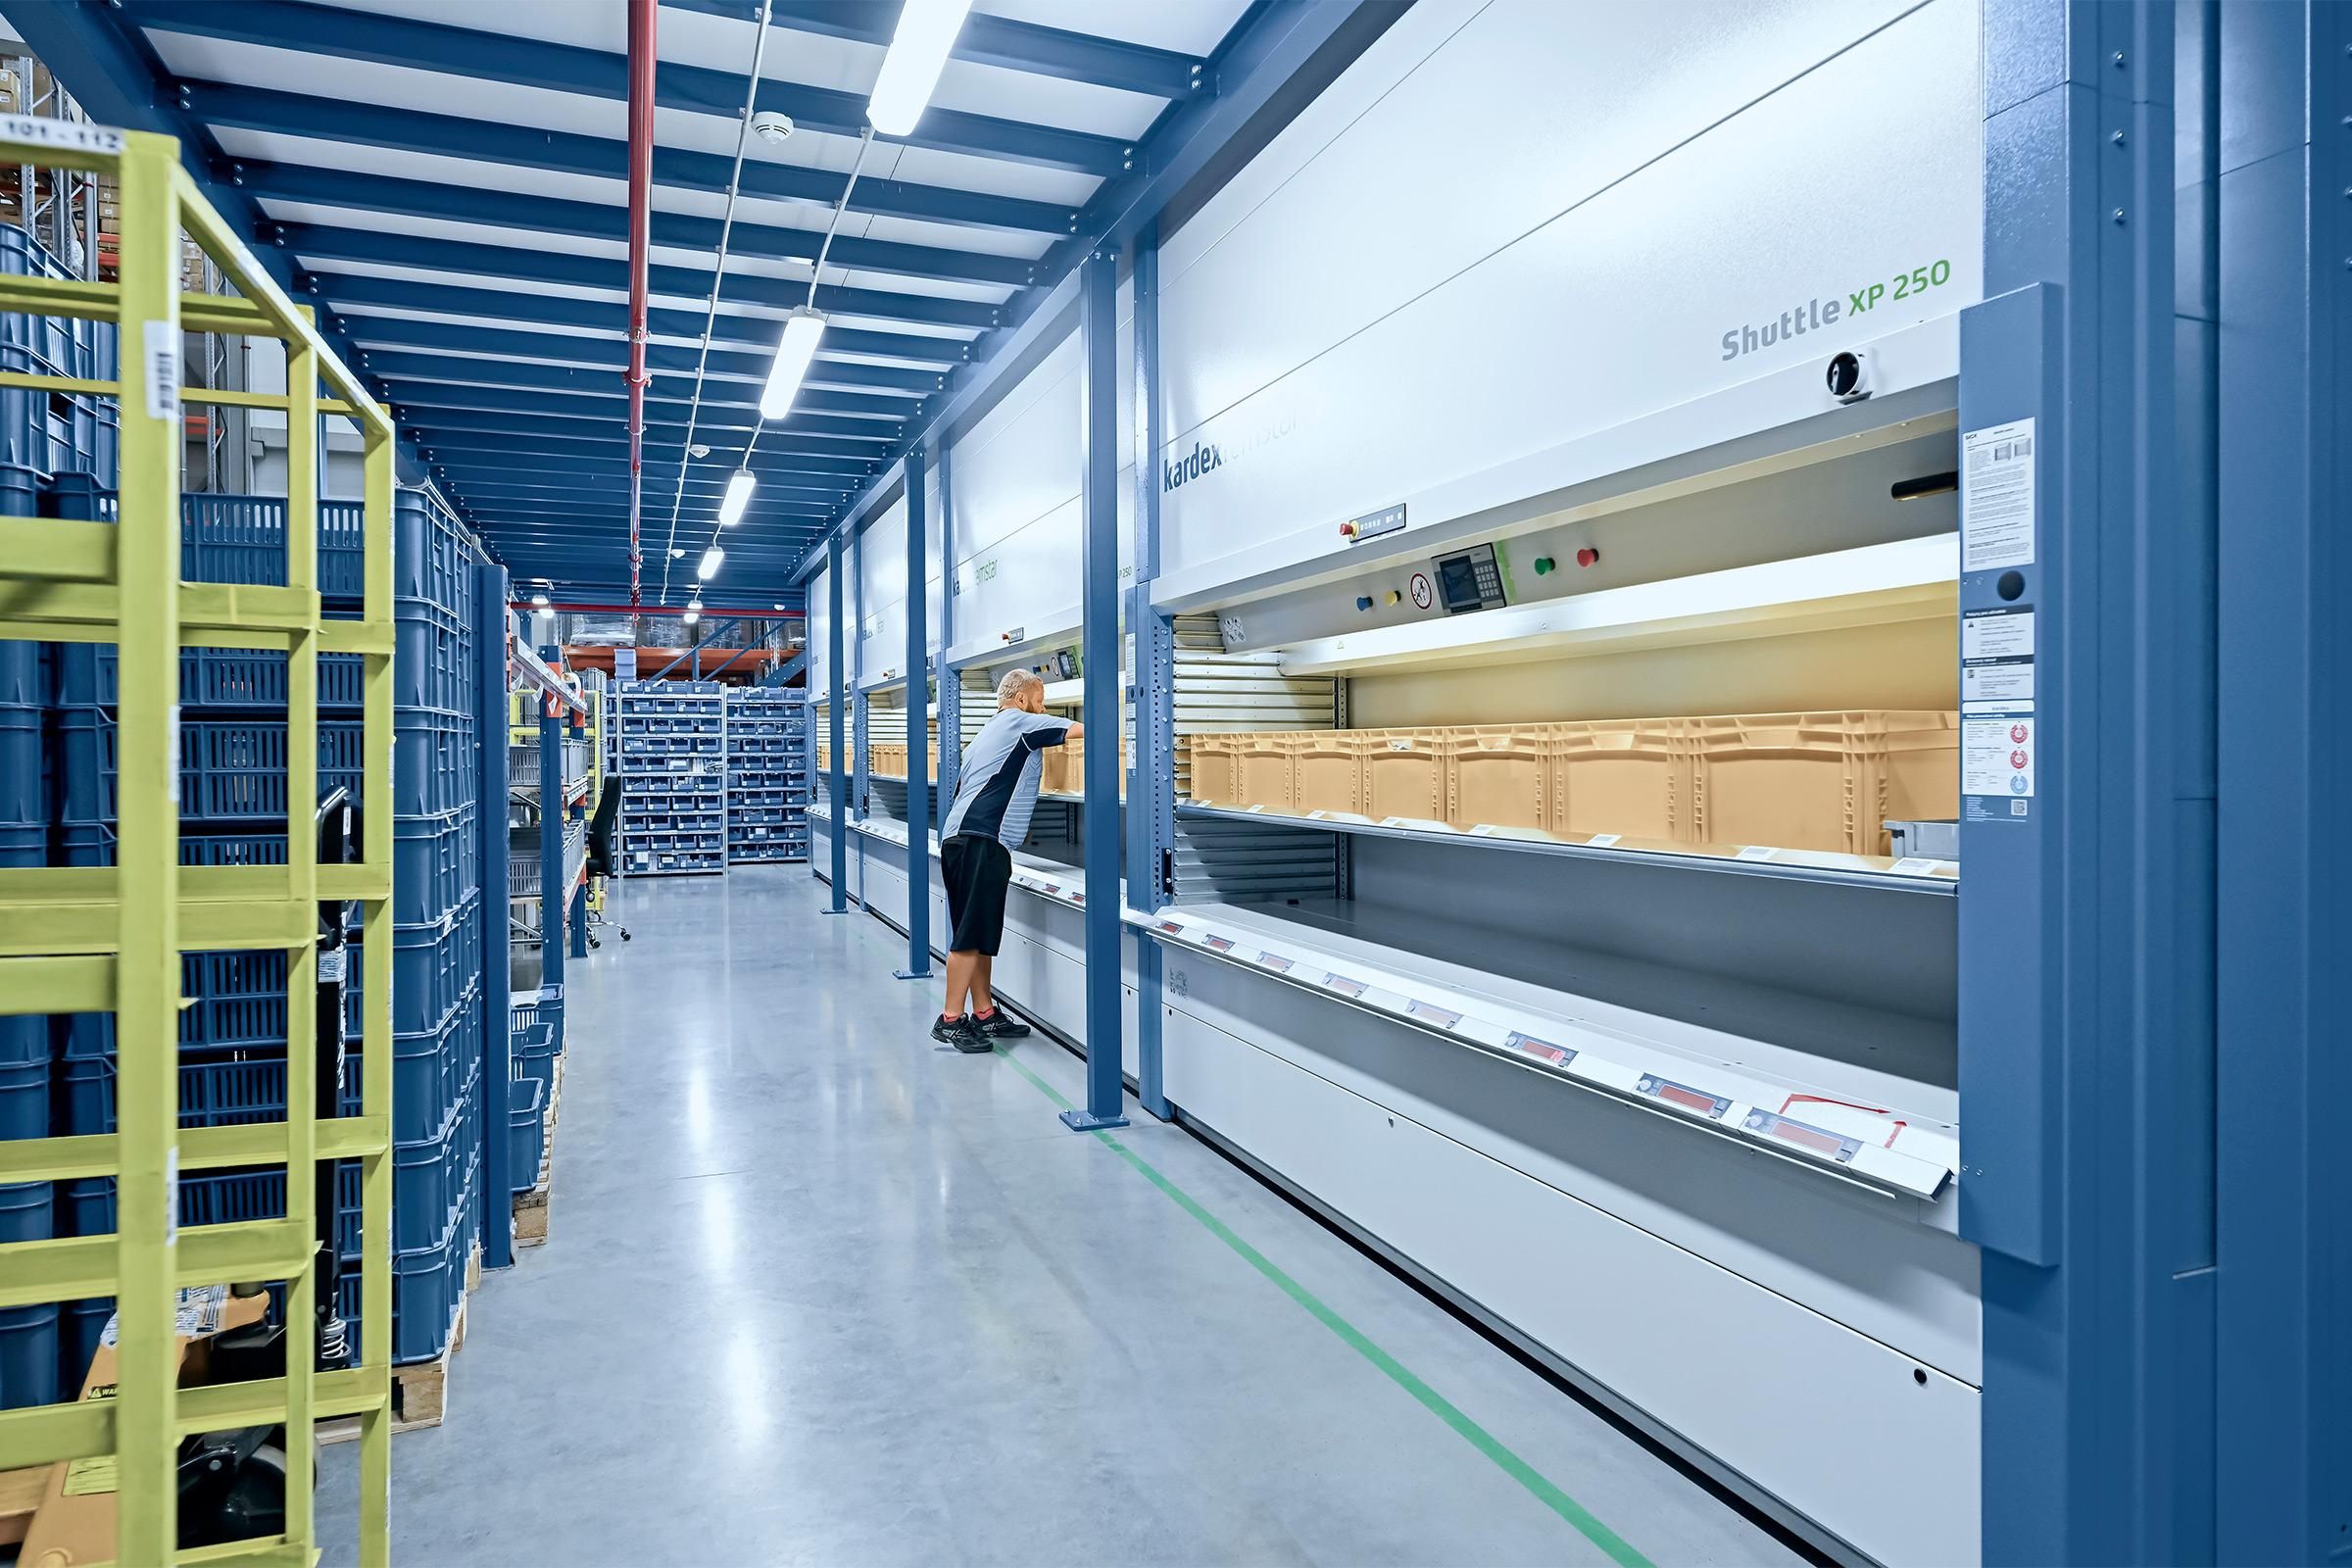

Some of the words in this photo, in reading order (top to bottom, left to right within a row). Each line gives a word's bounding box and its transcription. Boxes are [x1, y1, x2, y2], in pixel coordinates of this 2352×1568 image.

[1722, 298, 1840, 361] Shuttle
[1848, 283, 1885, 317] XP
[1892, 259, 1950, 301] 250
